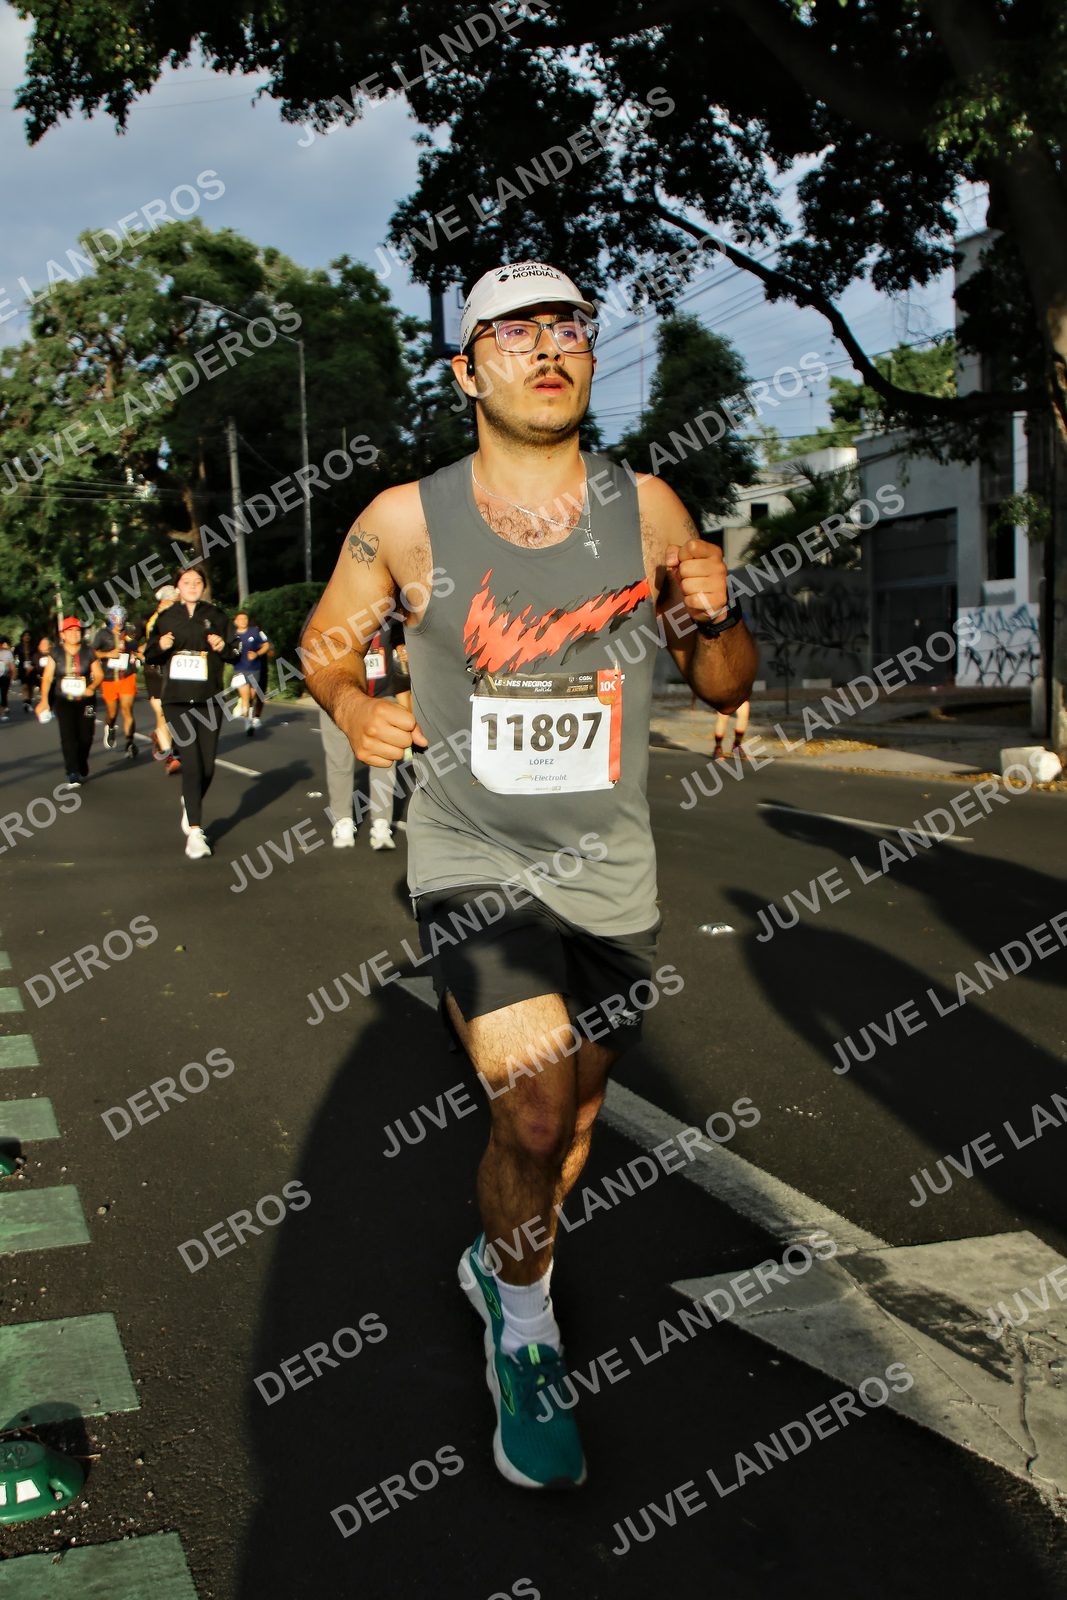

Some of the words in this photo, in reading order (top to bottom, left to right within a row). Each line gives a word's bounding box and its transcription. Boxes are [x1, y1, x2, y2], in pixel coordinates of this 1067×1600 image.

[511, 264, 538, 274] AG2R
[539, 264, 553, 273] LA
[176, 658, 201, 669] 6172
[522, 680, 553, 688] NEGROS
[600, 680, 617, 692] 10K
[480, 711, 603, 753] 11897
